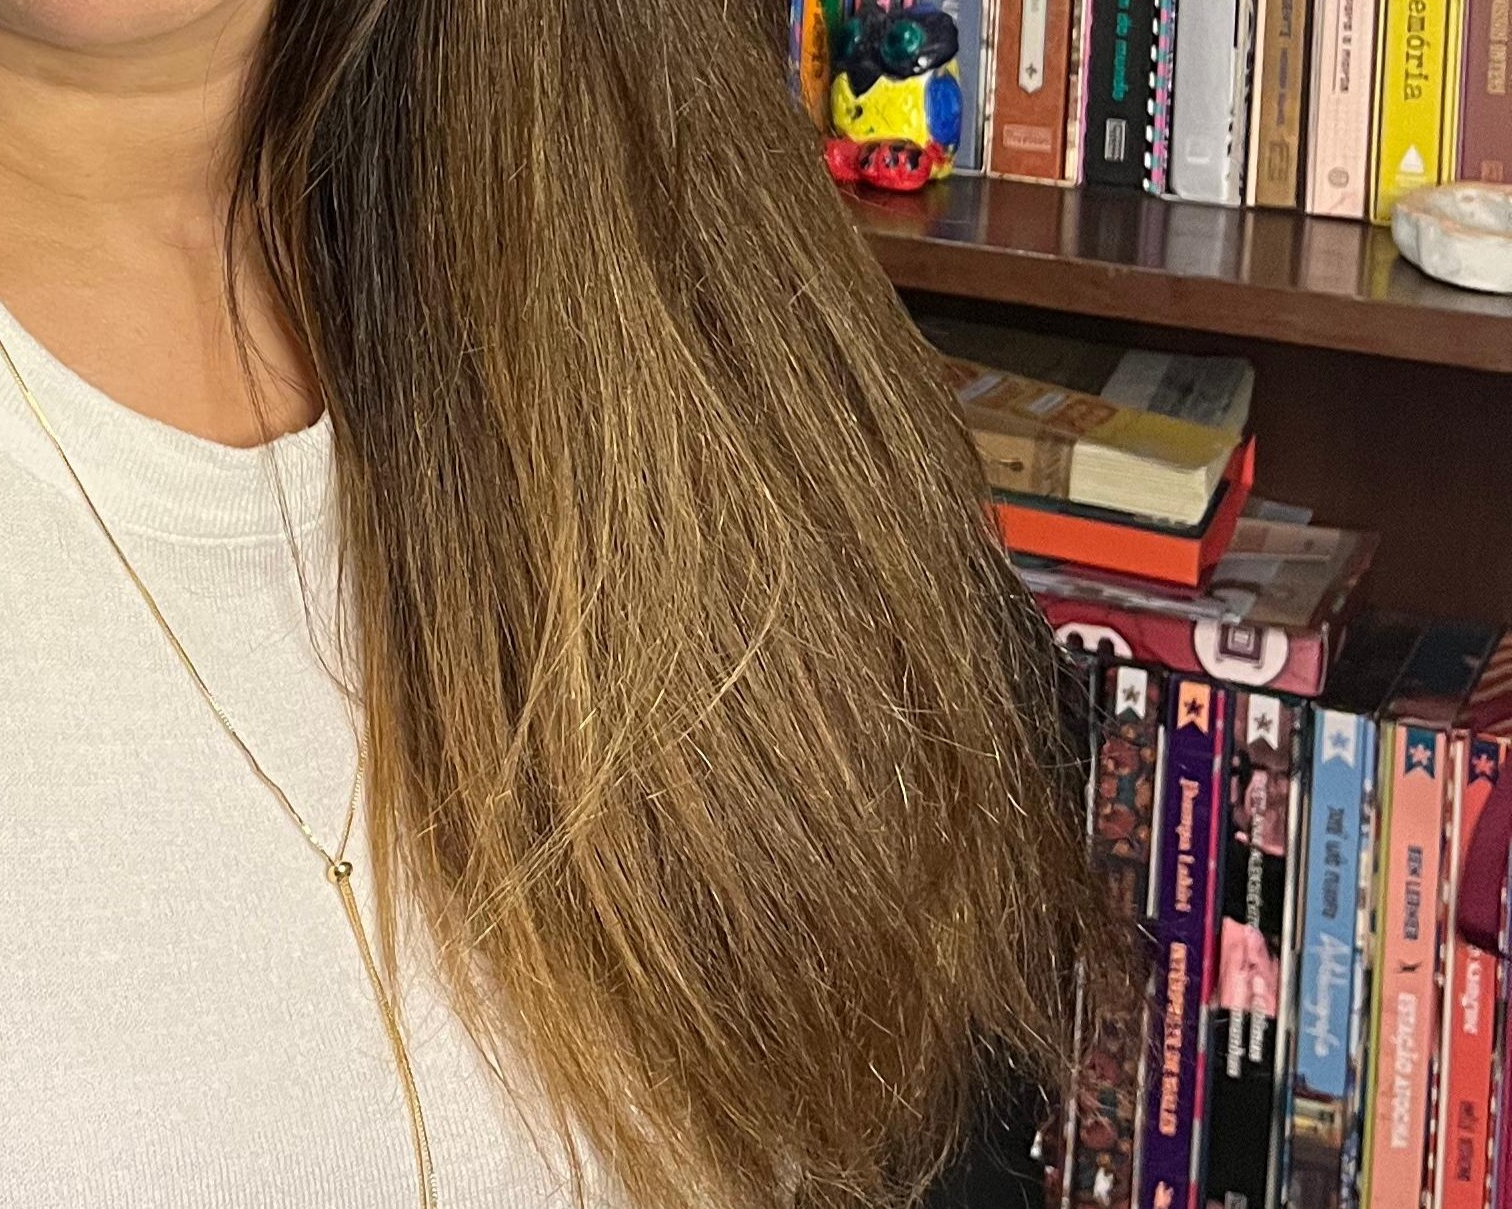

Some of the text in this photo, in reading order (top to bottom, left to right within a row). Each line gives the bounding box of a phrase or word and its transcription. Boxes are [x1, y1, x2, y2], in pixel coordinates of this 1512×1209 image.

[1115, 13, 1134, 37] do
[1111, 39, 1130, 101] mundo
[1339, 49, 1354, 93] norte
[1175, 776, 1200, 912] Jhumpa Lahiri
[1404, 846, 1423, 940] BEN LERNER
[1390, 993, 1418, 1148] ESTAÇÃO ATOCHA
